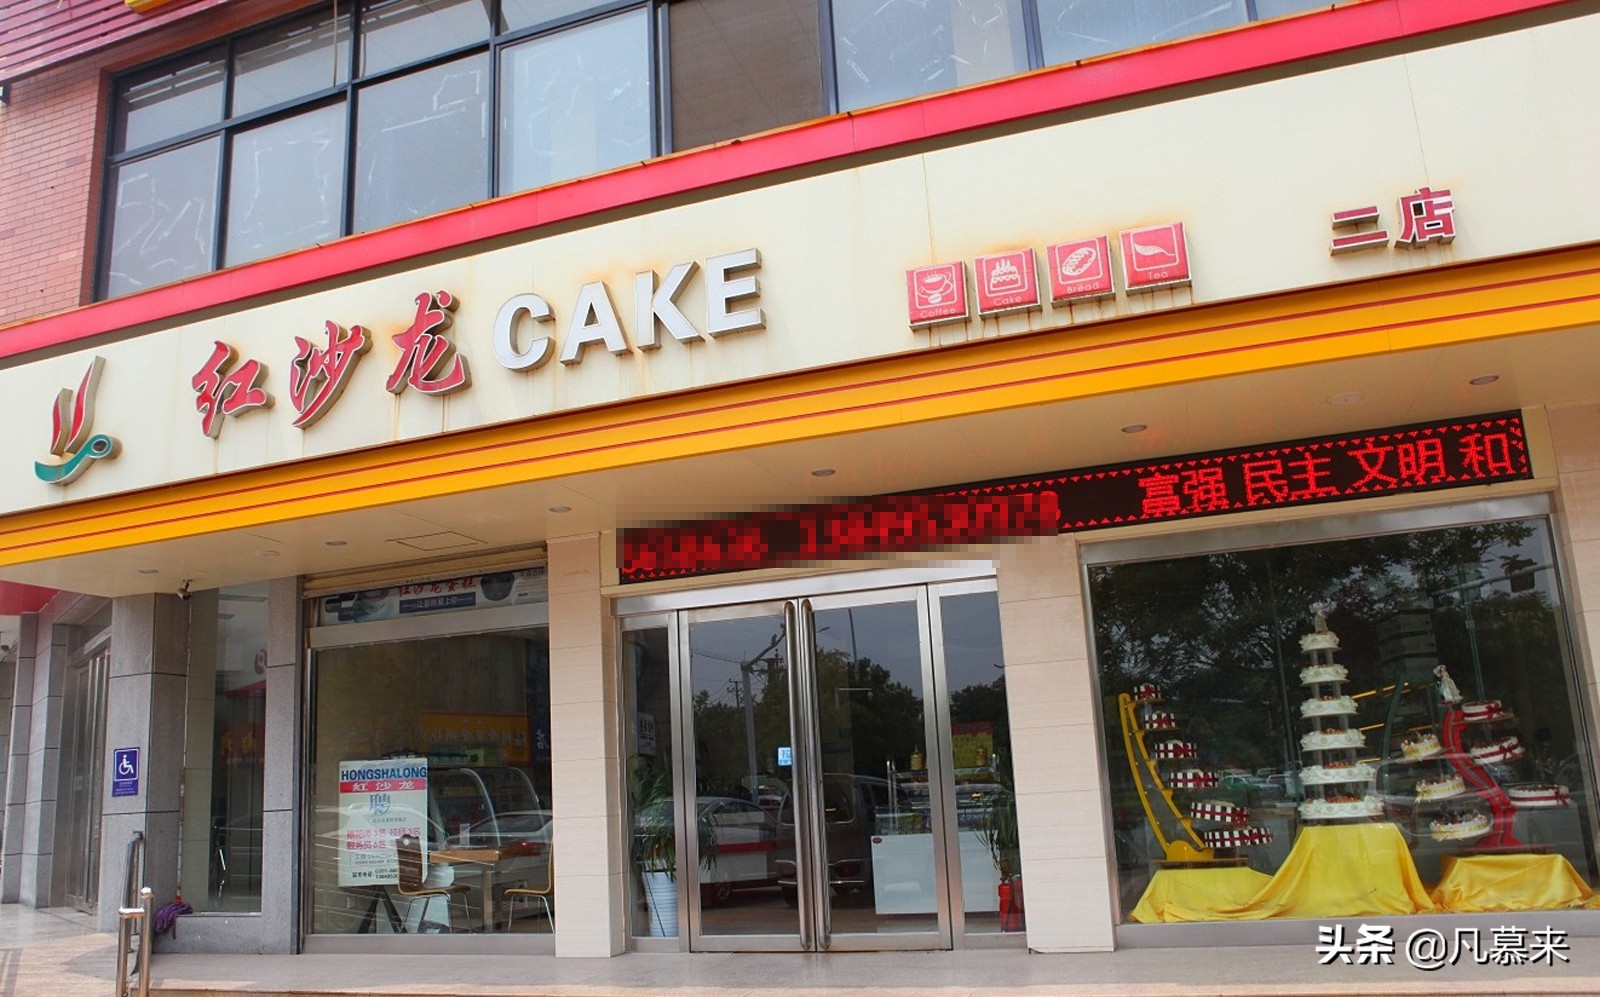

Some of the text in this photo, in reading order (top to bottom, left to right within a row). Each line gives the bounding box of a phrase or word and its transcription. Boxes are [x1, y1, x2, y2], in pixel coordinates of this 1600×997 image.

[1330, 186, 1455, 254] 二店
[1146, 270, 1168, 280] Tea
[1066, 281, 1099, 294] Bread
[993, 294, 1022, 306] Cake
[919, 306, 956, 319] Coffee
[191, 247, 766, 438] 红沙龙 CAKE
[1138, 431, 1512, 514] 富强 民主 文明 和
[341, 766, 427, 780] HONGSHALONG
[352, 780, 415, 792] 红沙龙
